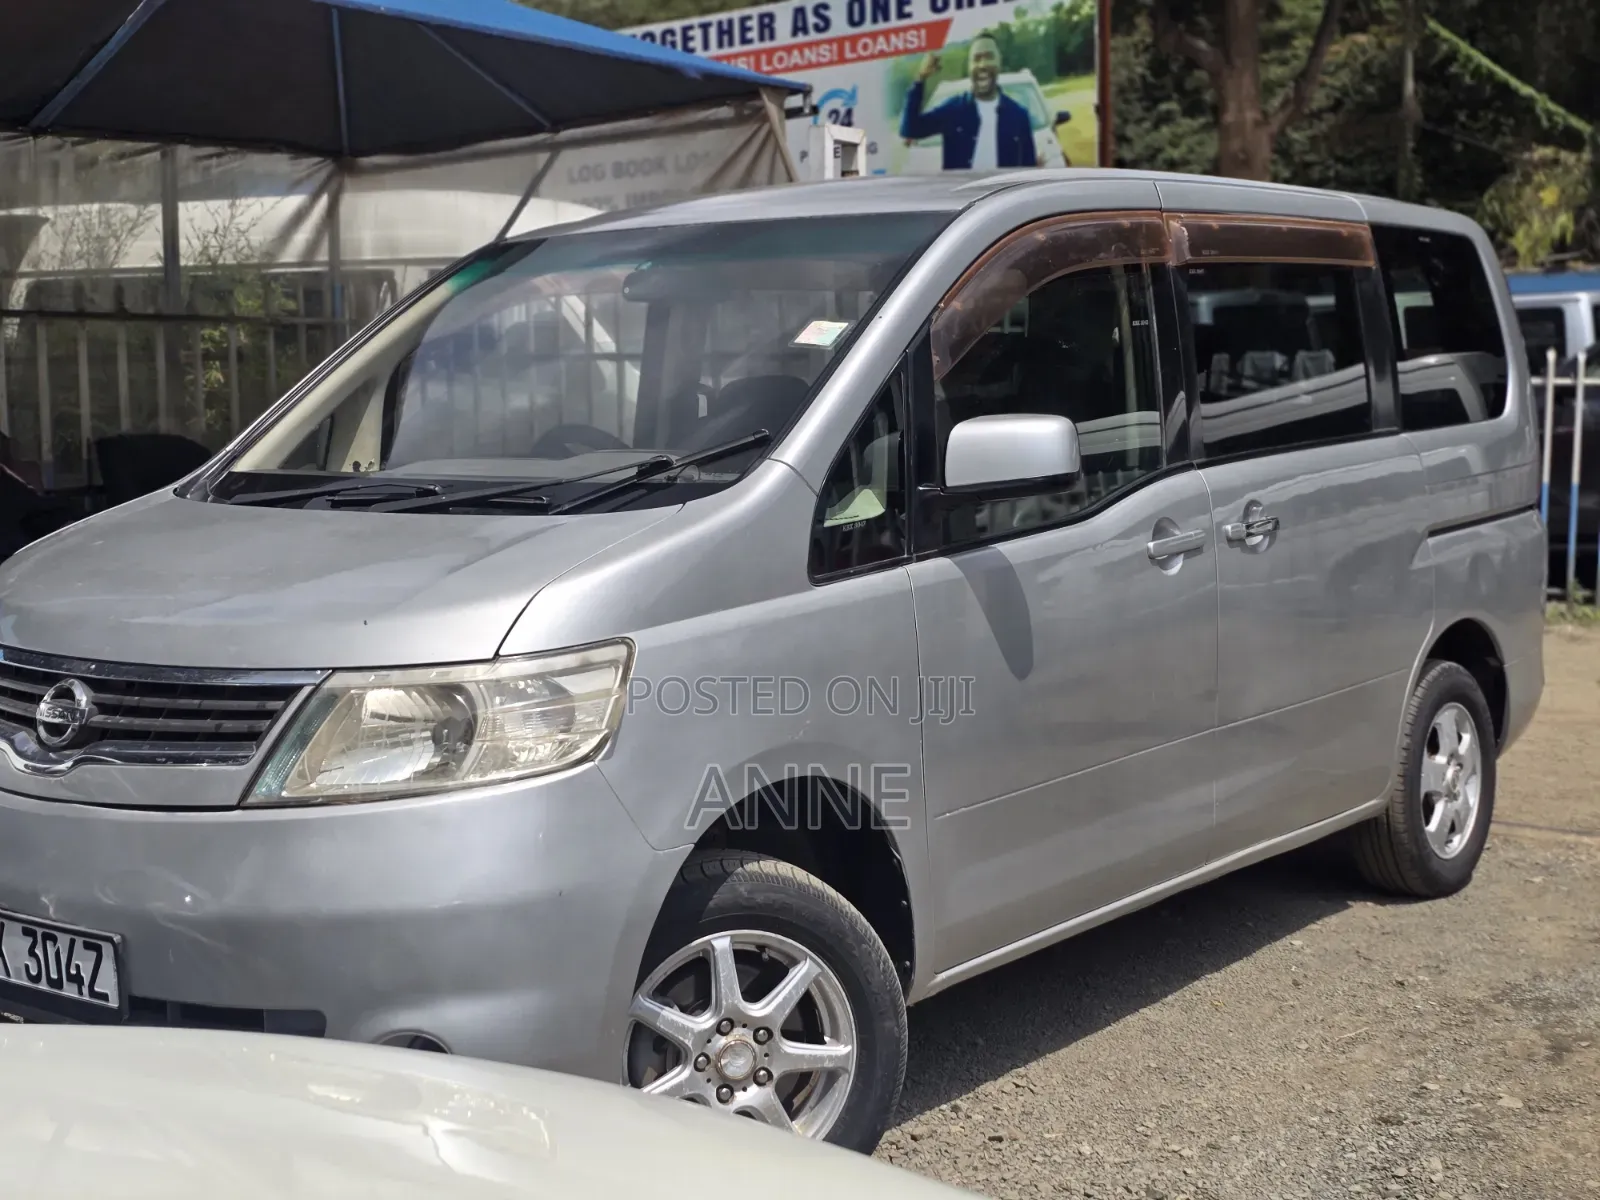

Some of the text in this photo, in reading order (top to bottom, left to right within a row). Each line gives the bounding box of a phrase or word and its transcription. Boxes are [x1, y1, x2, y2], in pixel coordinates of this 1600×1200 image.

[629, 0, 913, 53] GETHER AS ONE
[761, 41, 838, 71] LOANS!
[844, 30, 926, 59] LOANS!
[828, 107, 853, 127] 24
[566, 164, 606, 184] LOG
[611, 155, 667, 180] BOOK
[39, 705, 76, 721] NISSAN
[21, 925, 110, 1003] 304Z
